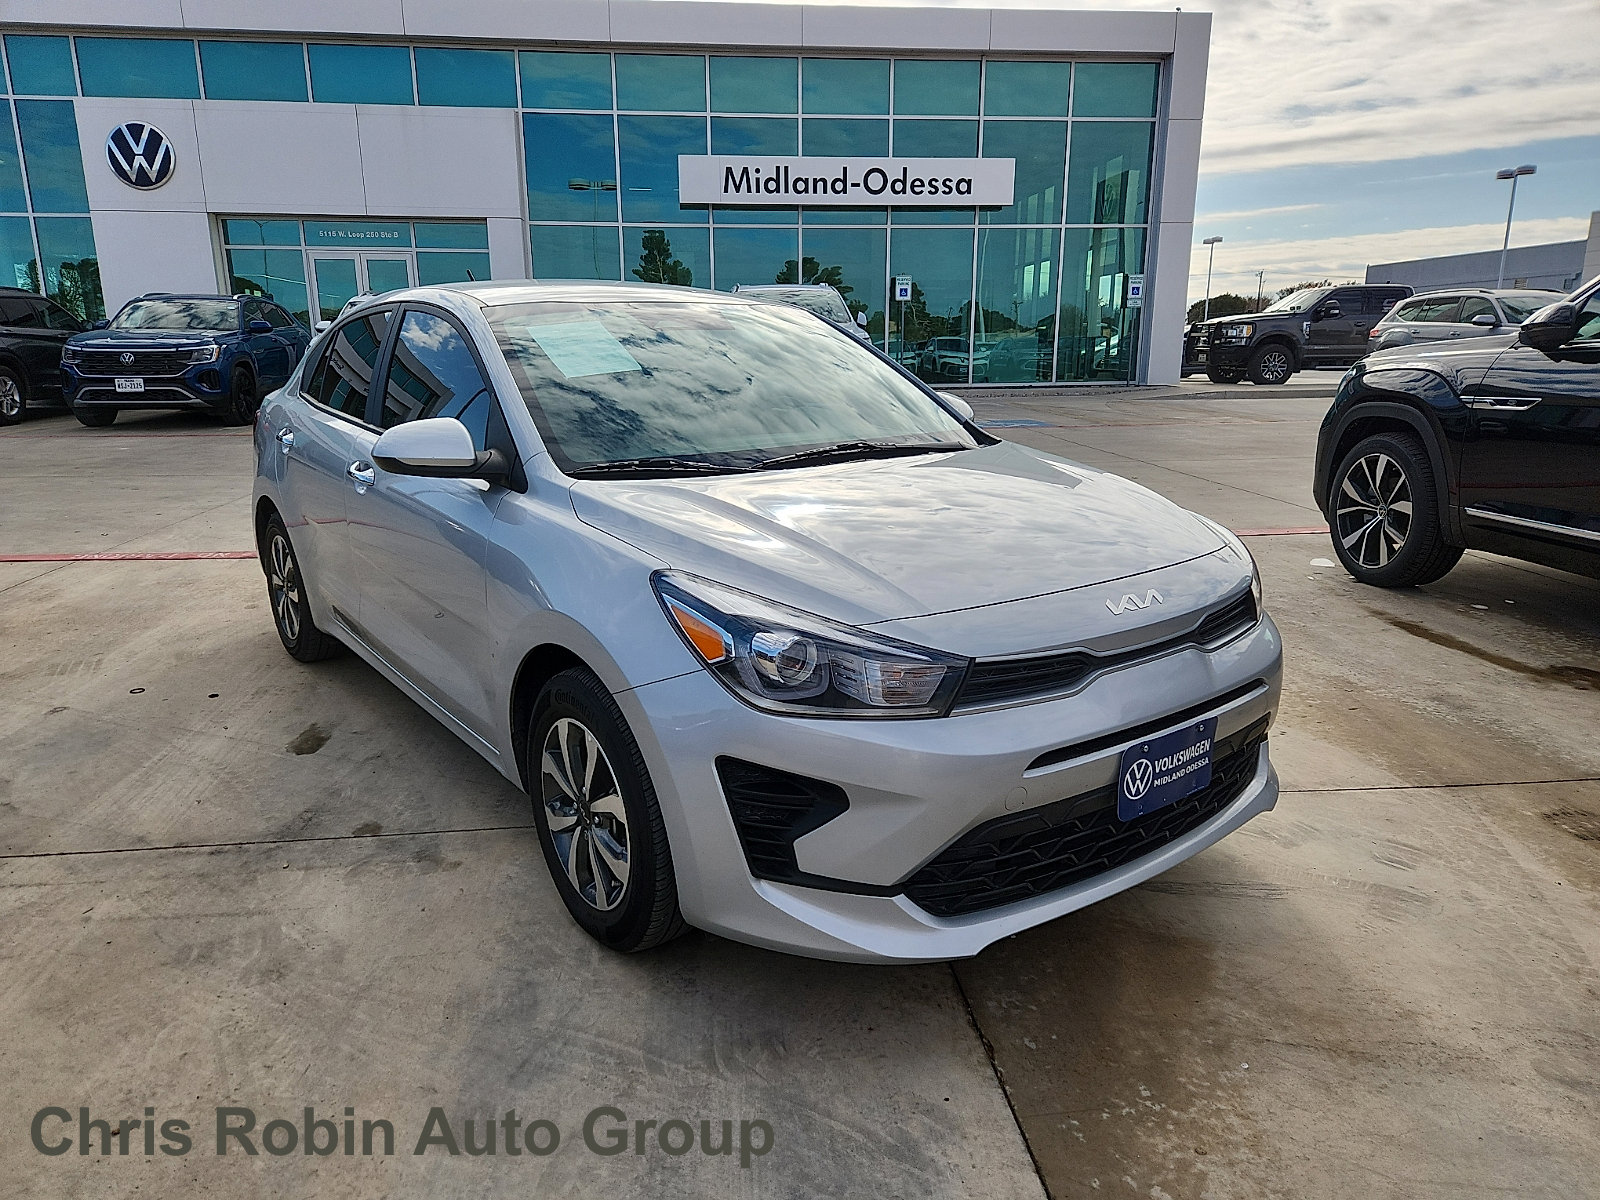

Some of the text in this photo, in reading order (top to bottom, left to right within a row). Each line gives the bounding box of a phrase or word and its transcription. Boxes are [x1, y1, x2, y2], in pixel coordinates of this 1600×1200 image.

[723, 165, 973, 196] Midland-Odessa
[338, 230, 347, 238] W.
[348, 231, 365, 239] Loop
[1154, 738, 1211, 774] VOLKSWAGEN
[1153, 756, 1209, 788] MIDLAND ODESSA
